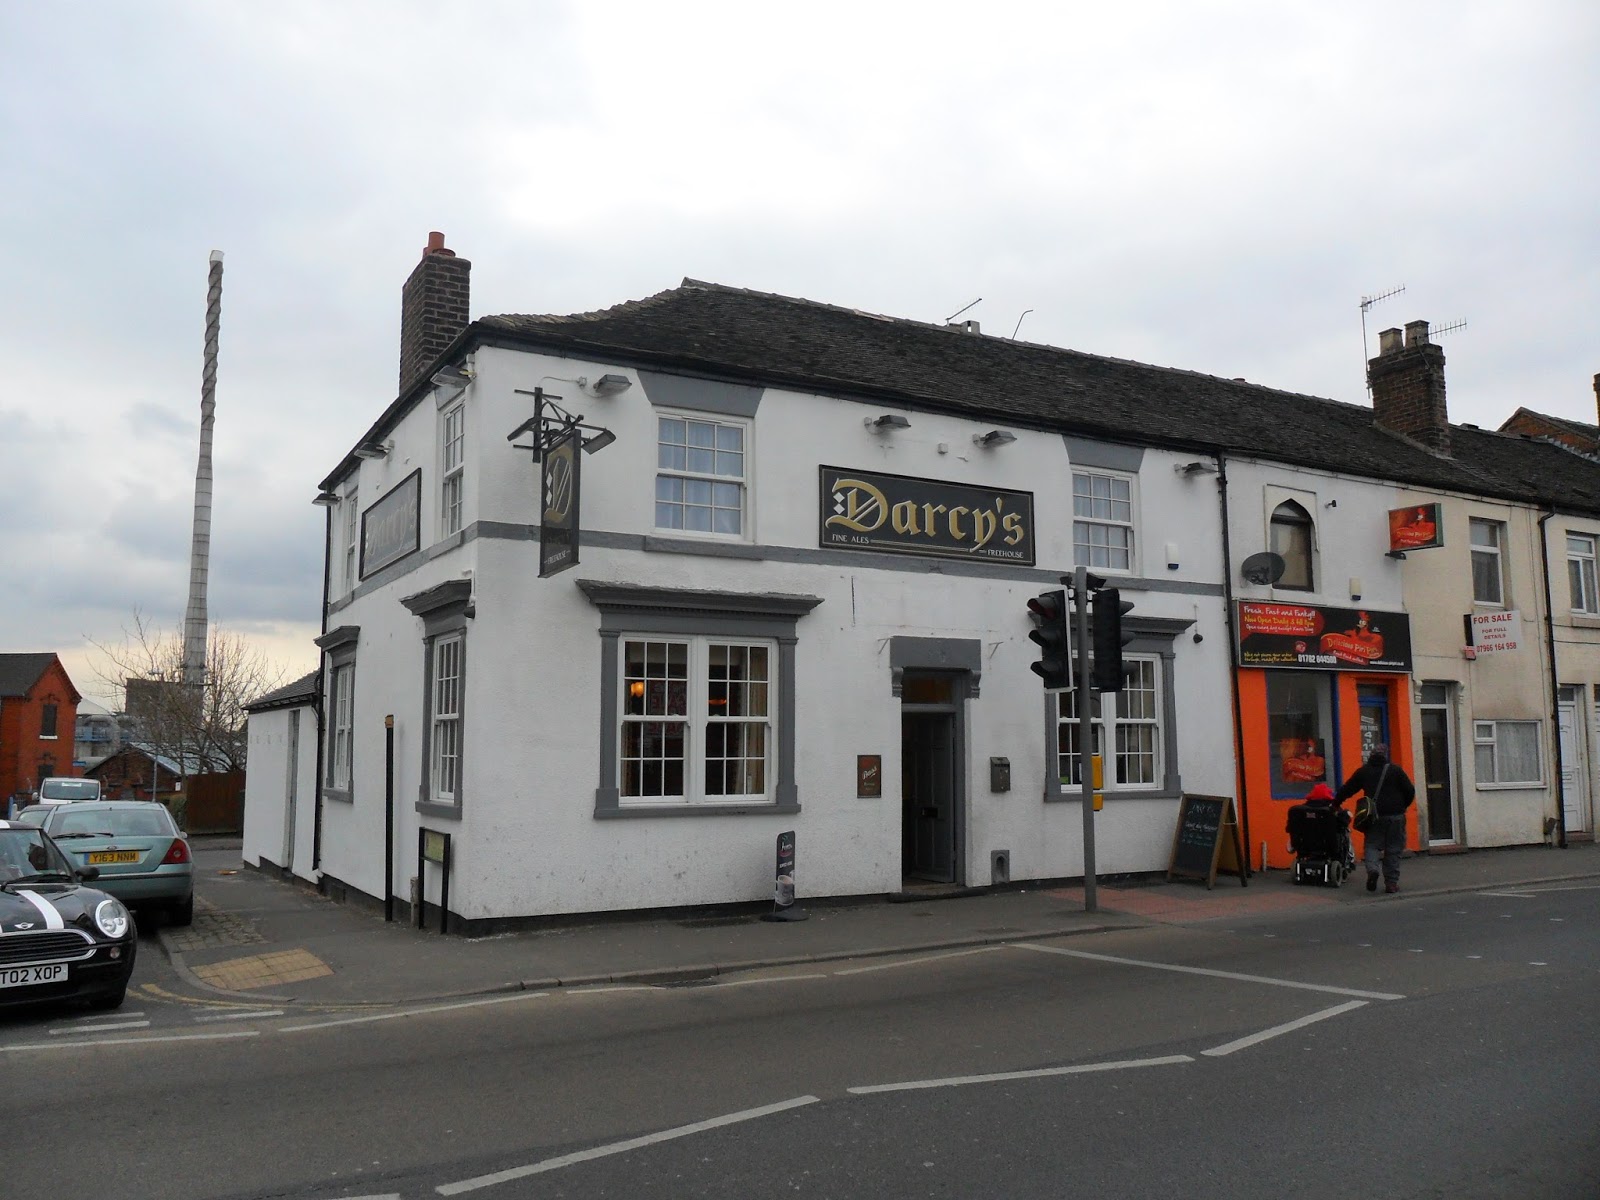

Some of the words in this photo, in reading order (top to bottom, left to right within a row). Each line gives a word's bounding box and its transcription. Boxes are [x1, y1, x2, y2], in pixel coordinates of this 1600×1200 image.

[825, 478, 1024, 553] Darcy's
[832, 533, 848, 543] FINE
[850, 535, 869, 544] ALES
[987, 548, 1024, 559] FREEHOUSE
[1473, 616, 1490, 624] FOR
[1491, 613, 1512, 623] SALE
[34, 965, 61, 981] XOP
